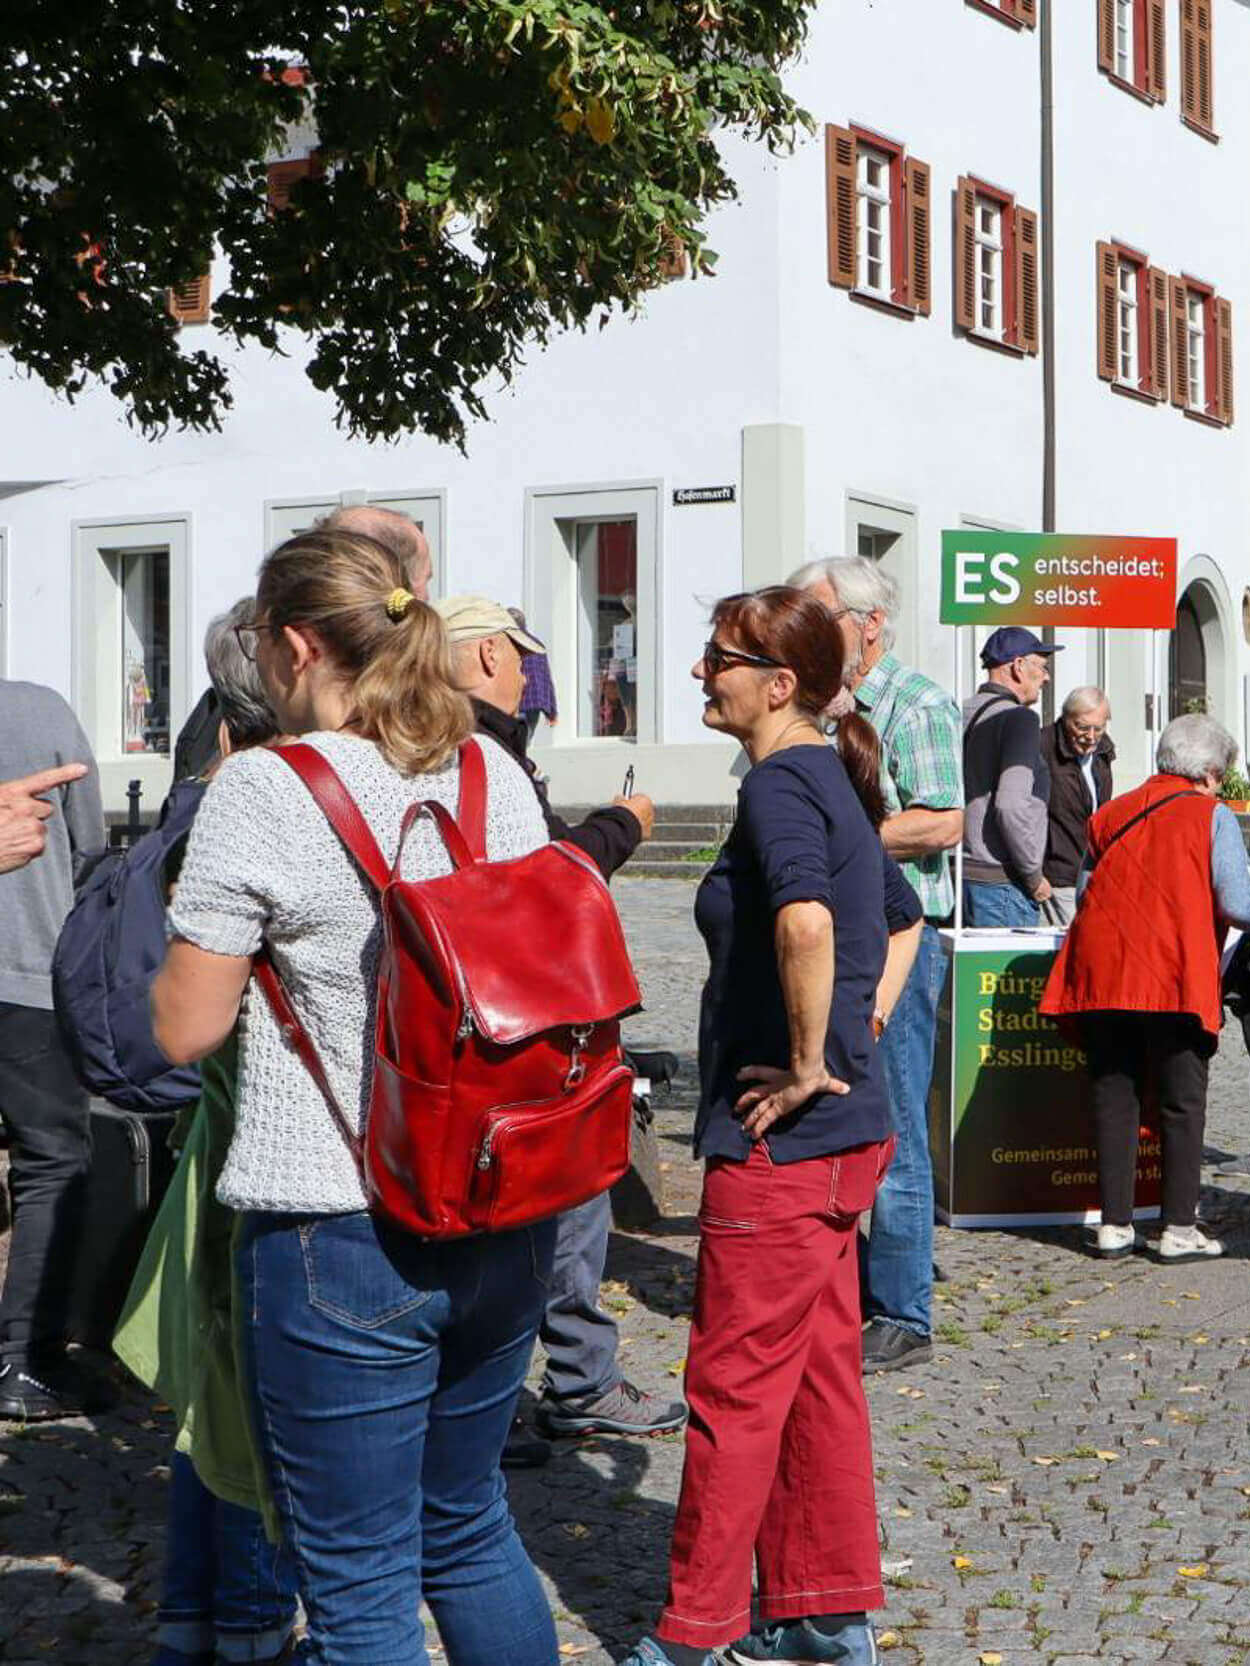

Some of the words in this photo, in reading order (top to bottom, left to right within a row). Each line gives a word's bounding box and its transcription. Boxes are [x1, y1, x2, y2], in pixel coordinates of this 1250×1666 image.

[954, 552, 1021, 605] ES
[1034, 555, 1165, 579] entscheidet;
[1034, 585, 1102, 607] selbst.
[991, 1146, 1089, 1164] Gemeinsam
